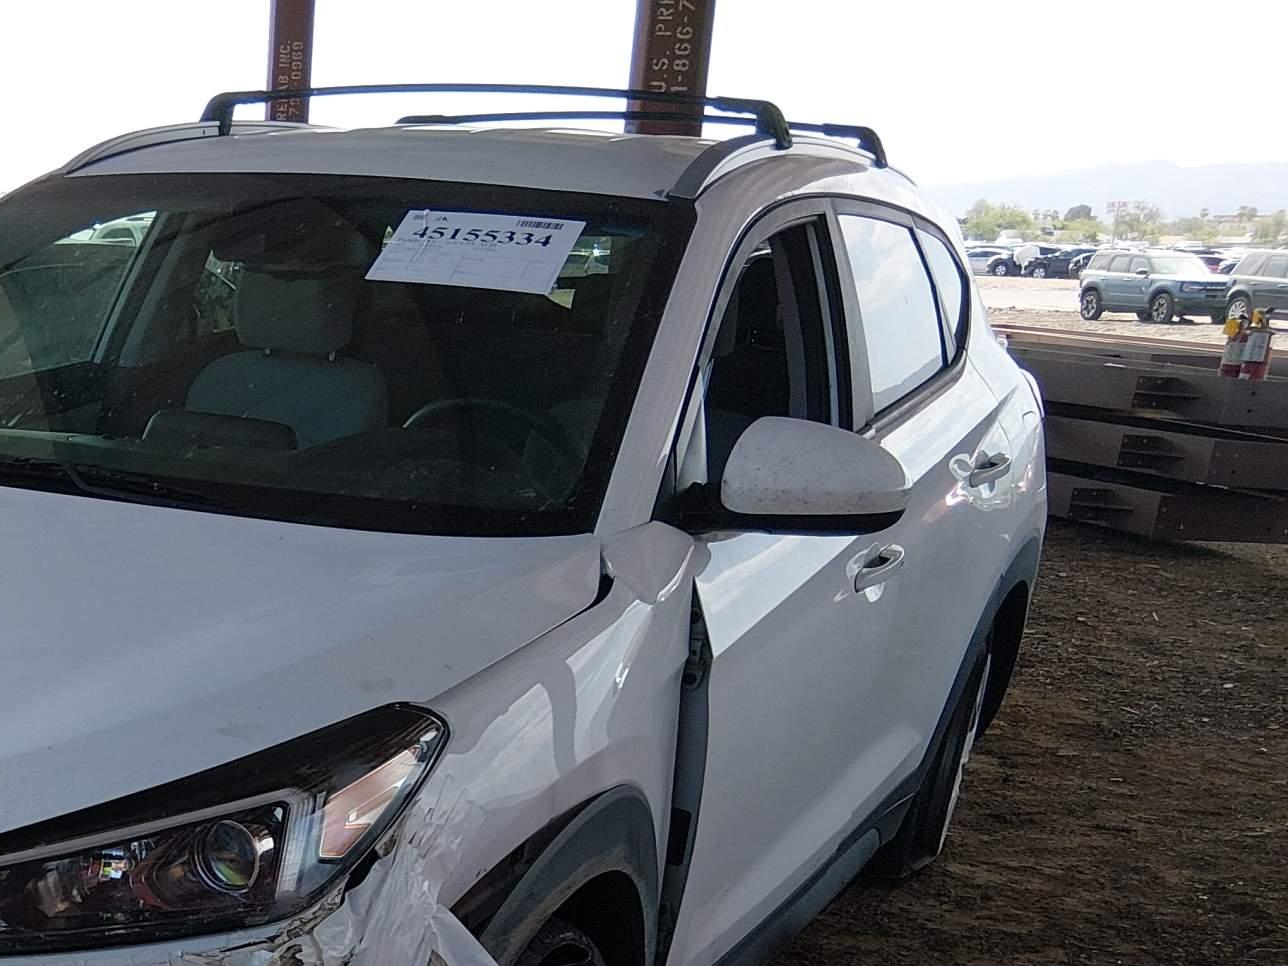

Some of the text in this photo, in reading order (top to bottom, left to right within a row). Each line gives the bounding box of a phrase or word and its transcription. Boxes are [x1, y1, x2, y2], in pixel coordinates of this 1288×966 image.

[278, 40, 291, 68] INC.
[649, 50, 670, 93] U.S.
[288, 41, 304, 116] 79-0969
[412, 226, 553, 247] 45155334
